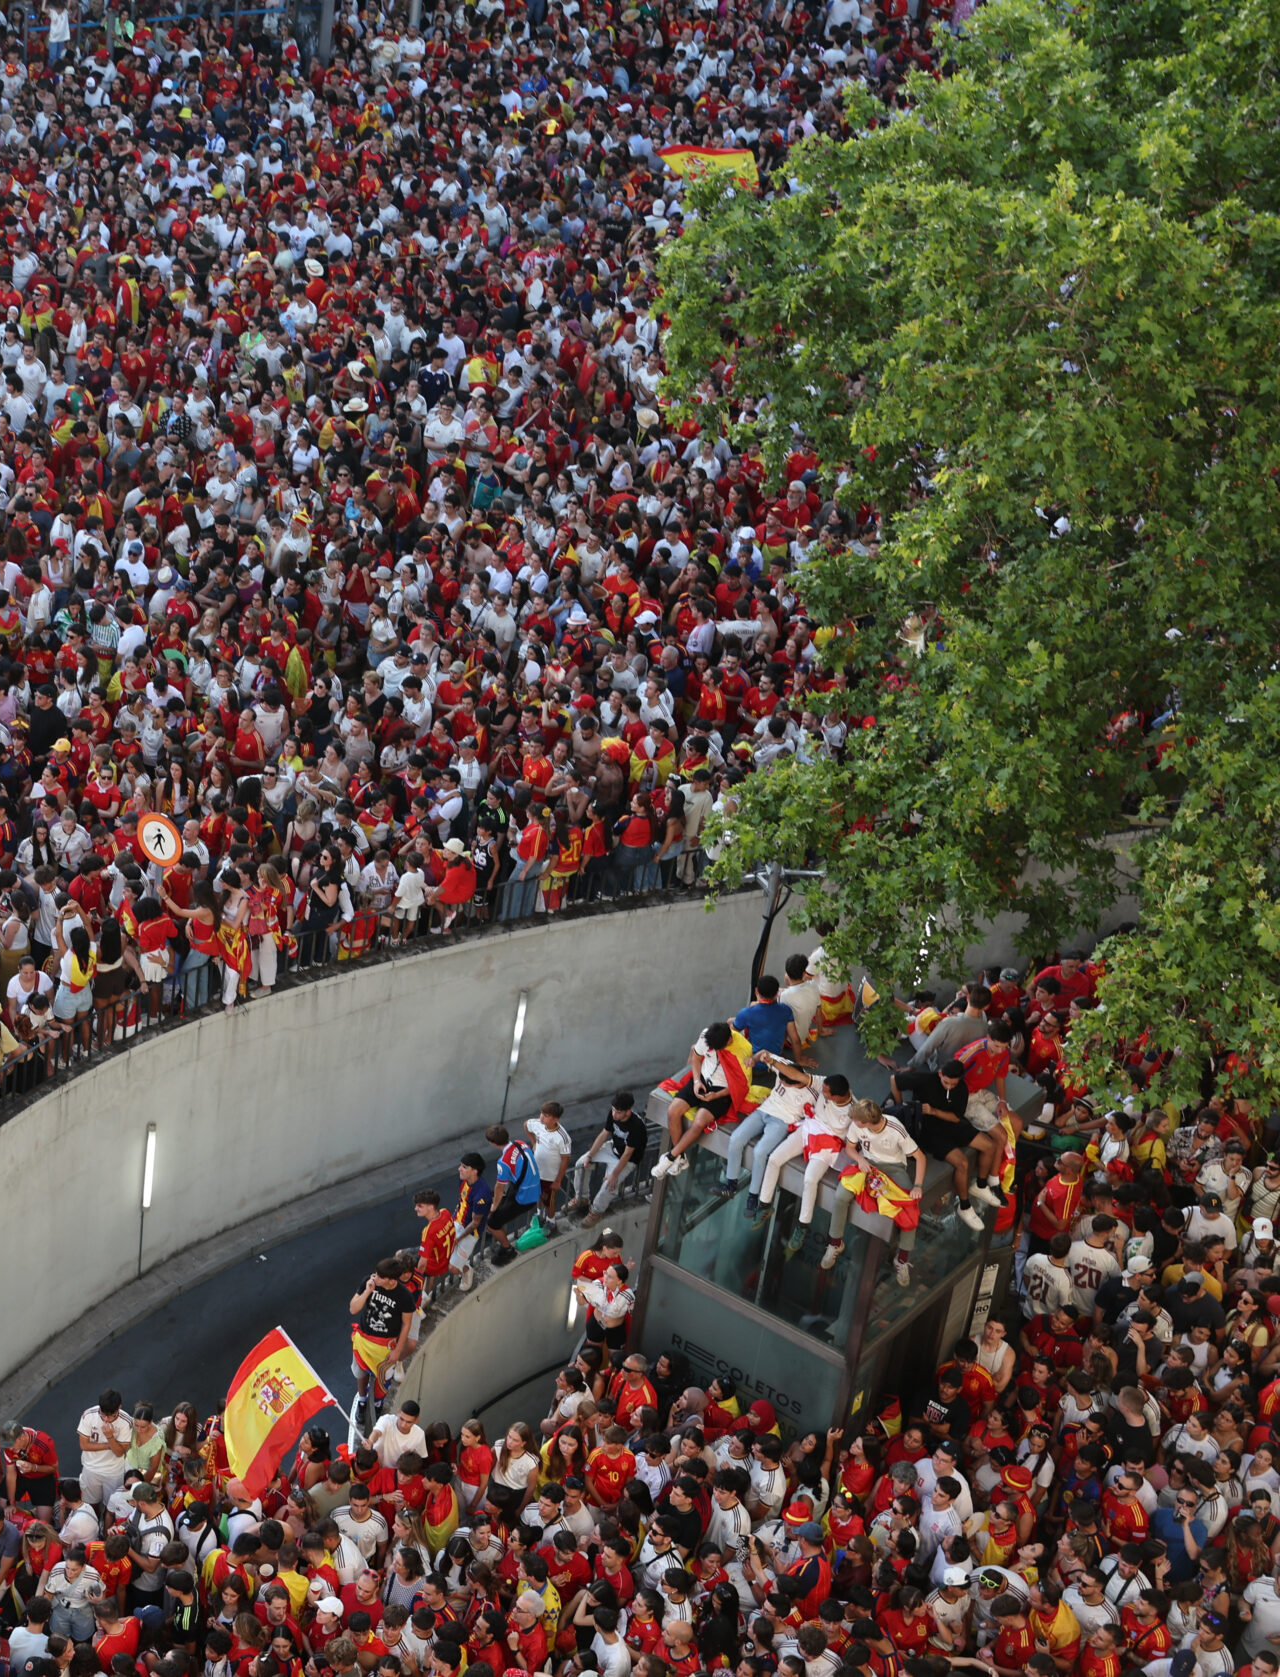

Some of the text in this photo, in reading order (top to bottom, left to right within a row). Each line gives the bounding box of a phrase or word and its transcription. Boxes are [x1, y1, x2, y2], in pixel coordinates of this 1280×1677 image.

[561, 840, 582, 862] 20
[1212, 1198, 1218, 1207] P
[1029, 1274, 1050, 1301] 21
[1073, 1263, 1102, 1290] 20
[371, 1290, 397, 1308] Tupac
[671, 1333, 803, 1415] RECOLETOS
[608, 1471, 619, 1483] 10
